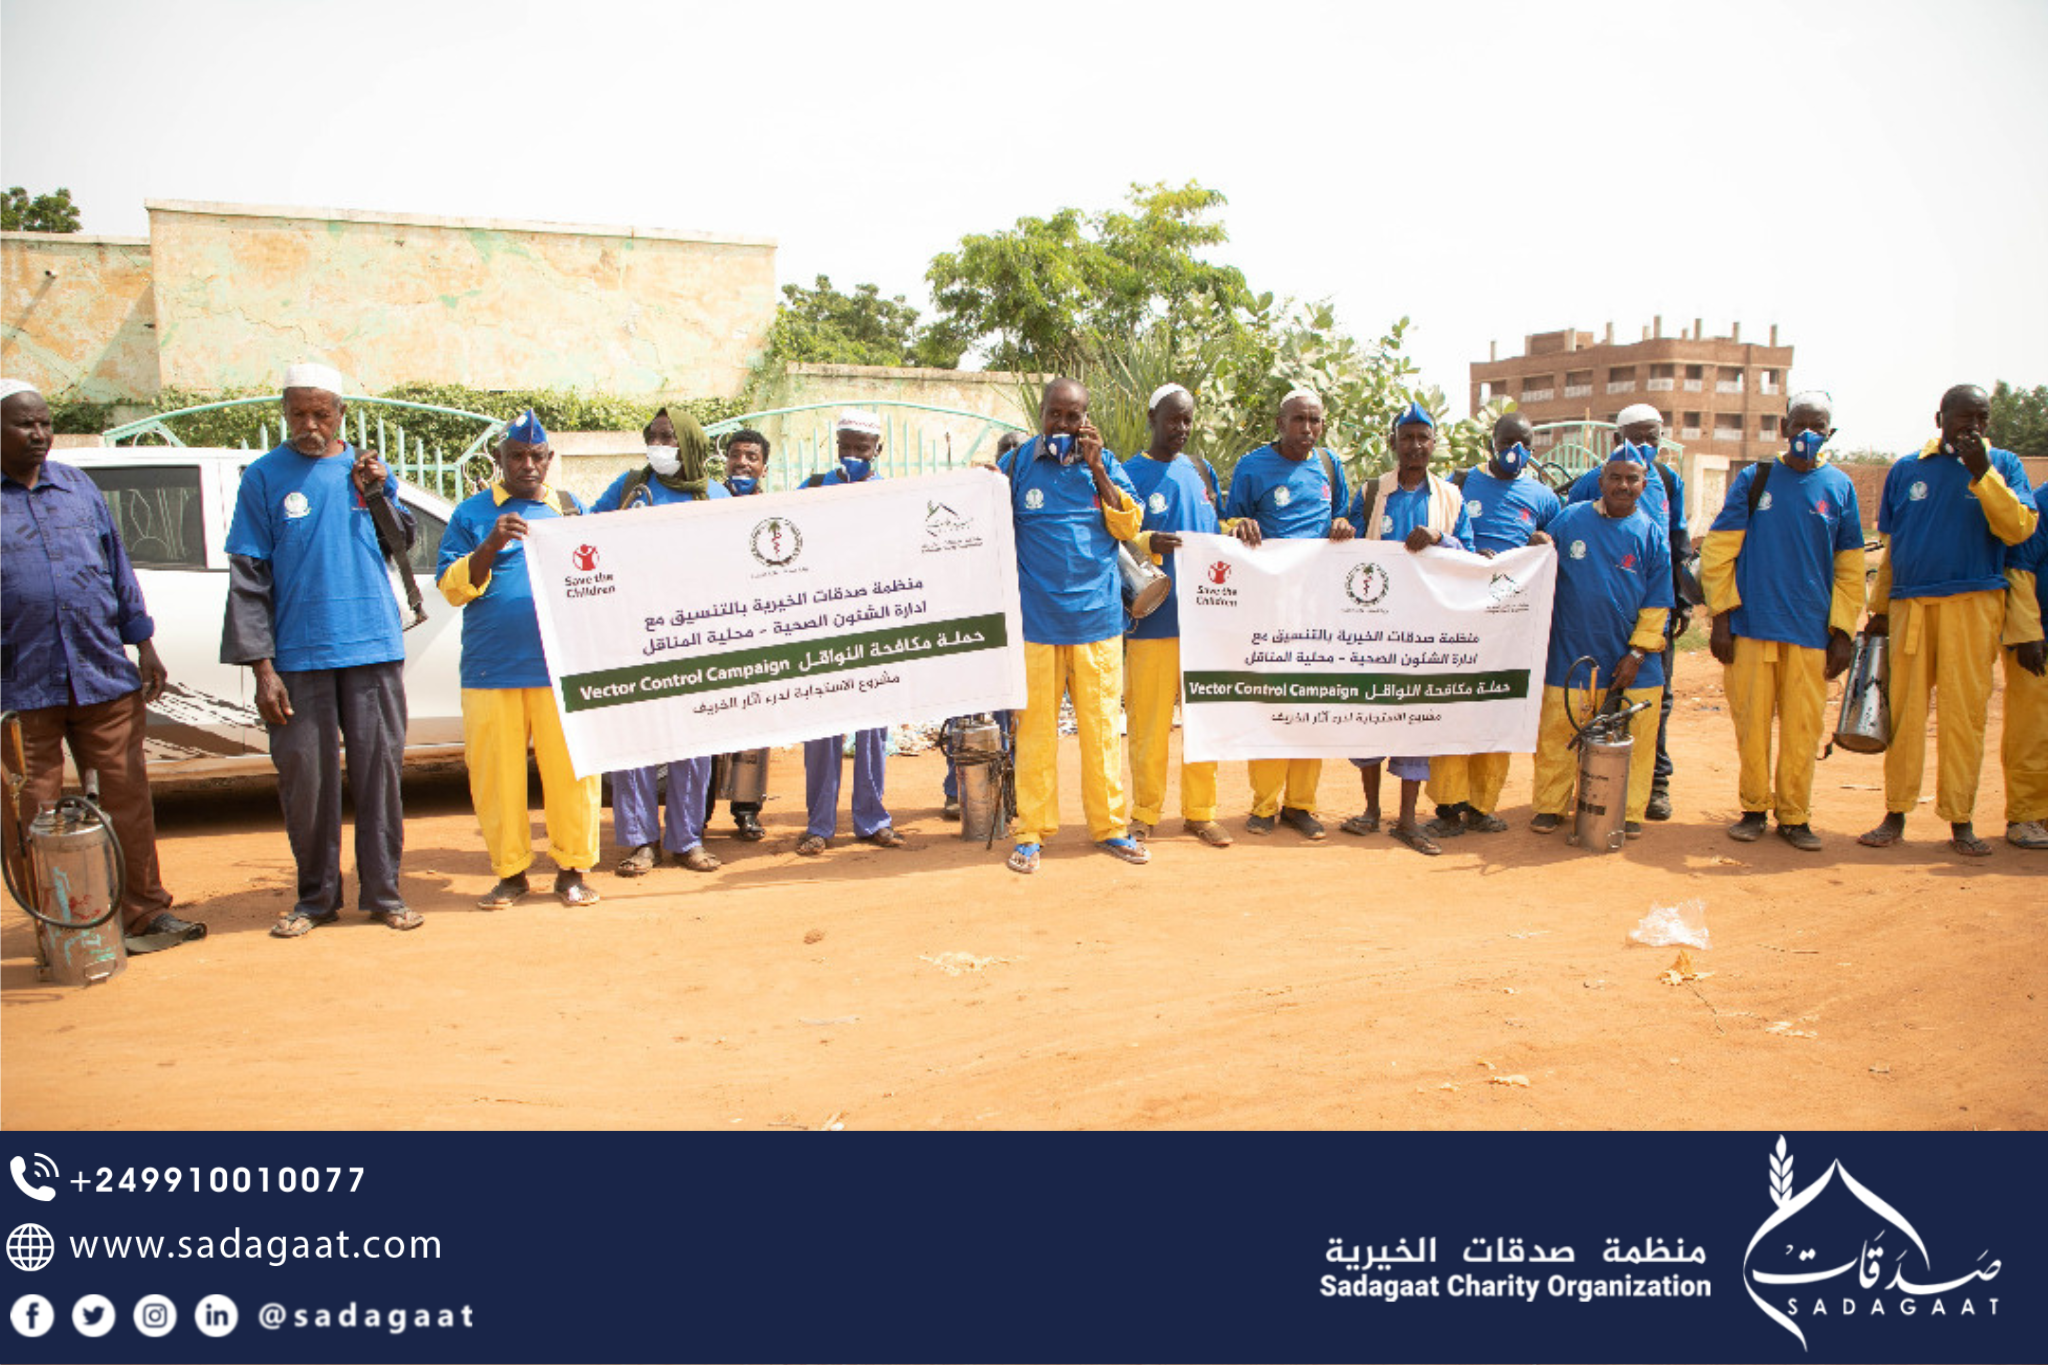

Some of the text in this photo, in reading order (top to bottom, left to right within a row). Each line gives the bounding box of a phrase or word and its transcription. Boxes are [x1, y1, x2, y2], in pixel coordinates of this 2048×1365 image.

[565, 576, 592, 587] Save
[567, 585, 615, 598] Children
[644, 578, 924, 632] منظمة صدقات الخيرية بالتنسيق مع
[773, 613, 828, 636] الصحية
[643, 631, 701, 656] المناقل
[707, 627, 754, 646] محلية
[1251, 629, 1480, 646] منظمة صدقات الخيرية بالتنسيق مع
[798, 631, 985, 672] حملة مكافحة النواقل
[1244, 651, 1292, 666] المناقل
[1296, 651, 1335, 666] محلية
[1350, 651, 1397, 667] الصحية
[580, 659, 790, 700] Vector Control Campaign
[858, 671, 900, 692] مشروع
[1189, 682, 1359, 700] Vector Control Campaign
[1365, 681, 1510, 700] حملة مكافحة النواقل
[692, 697, 737, 716] الخريف
